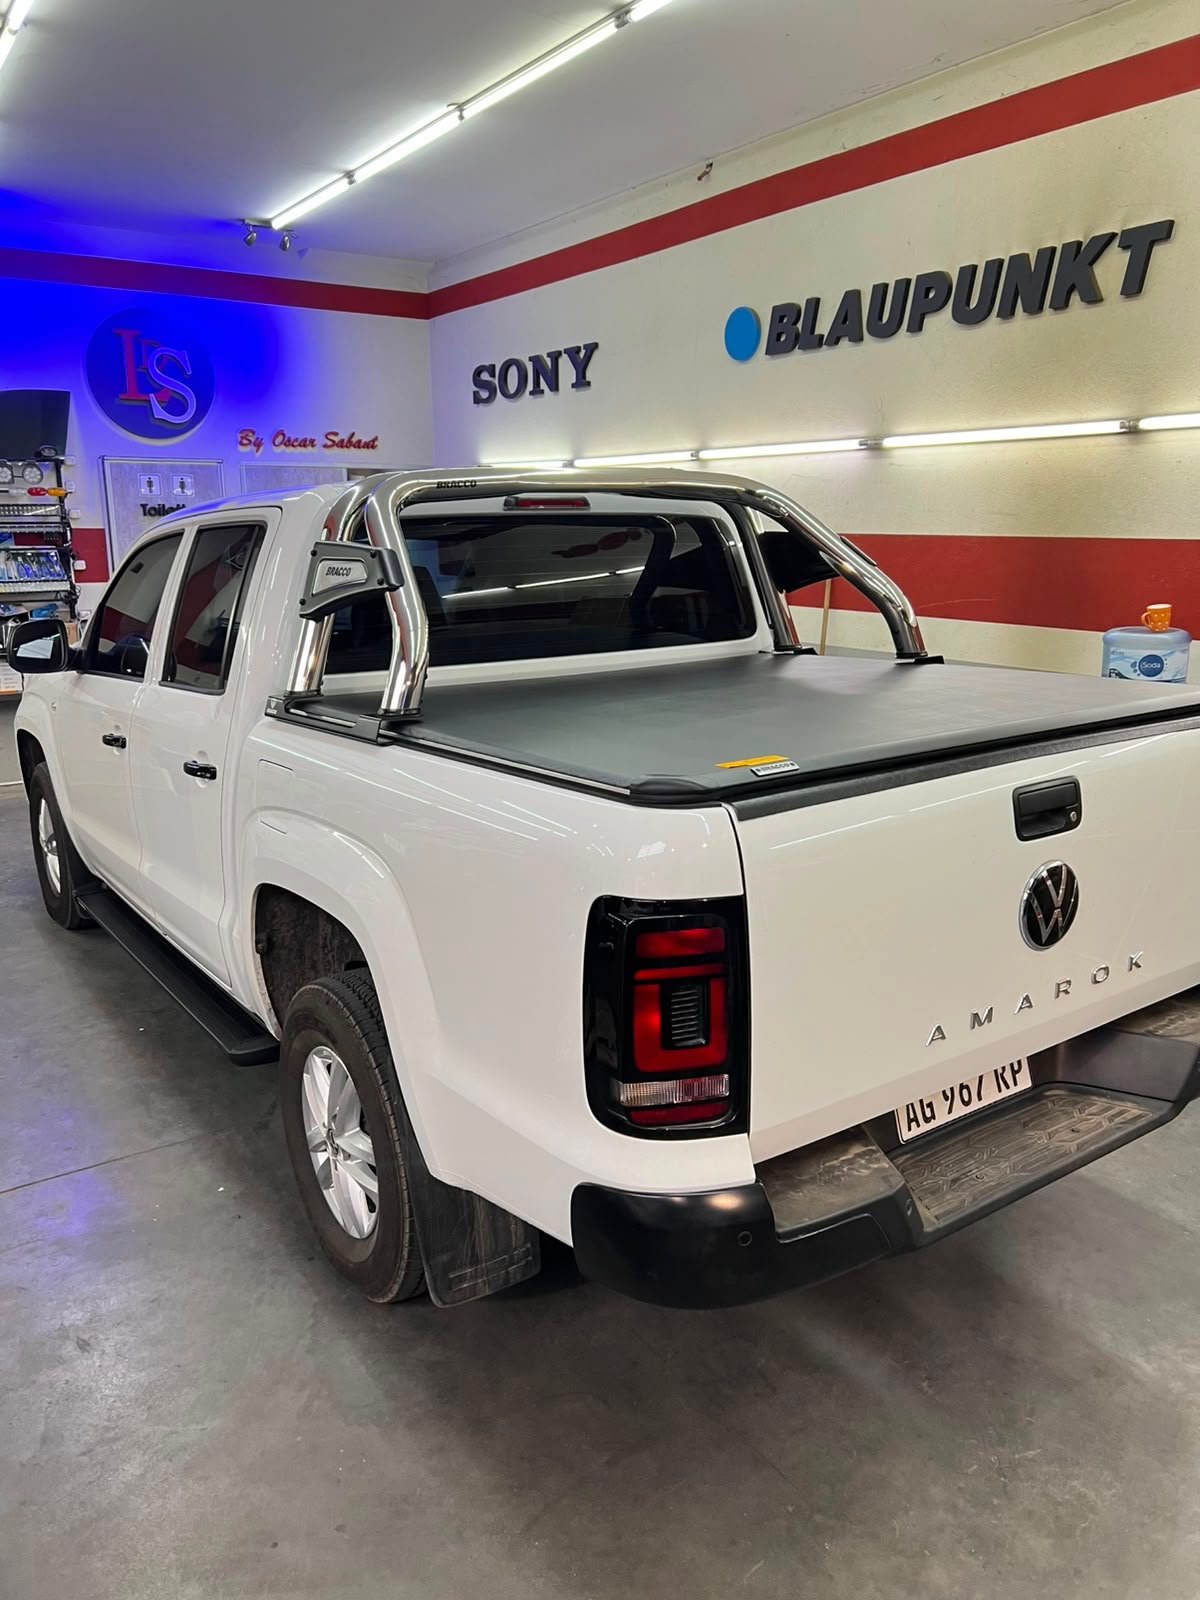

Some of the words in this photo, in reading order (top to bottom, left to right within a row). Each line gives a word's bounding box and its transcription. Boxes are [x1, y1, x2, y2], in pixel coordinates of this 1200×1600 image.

[765, 218, 1175, 356] BLAUPUNKT
[472, 341, 599, 405] SONY
[238, 428, 264, 453] By
[272, 429, 317, 449] Oscar
[436, 479, 477, 489] BRACCO
[325, 566, 352, 577] BRACCO
[1142, 661, 1161, 669] Soda
[925, 951, 1144, 1047] AMAROK
[905, 1098, 936, 1132] AG
[941, 1074, 984, 1115] 967
